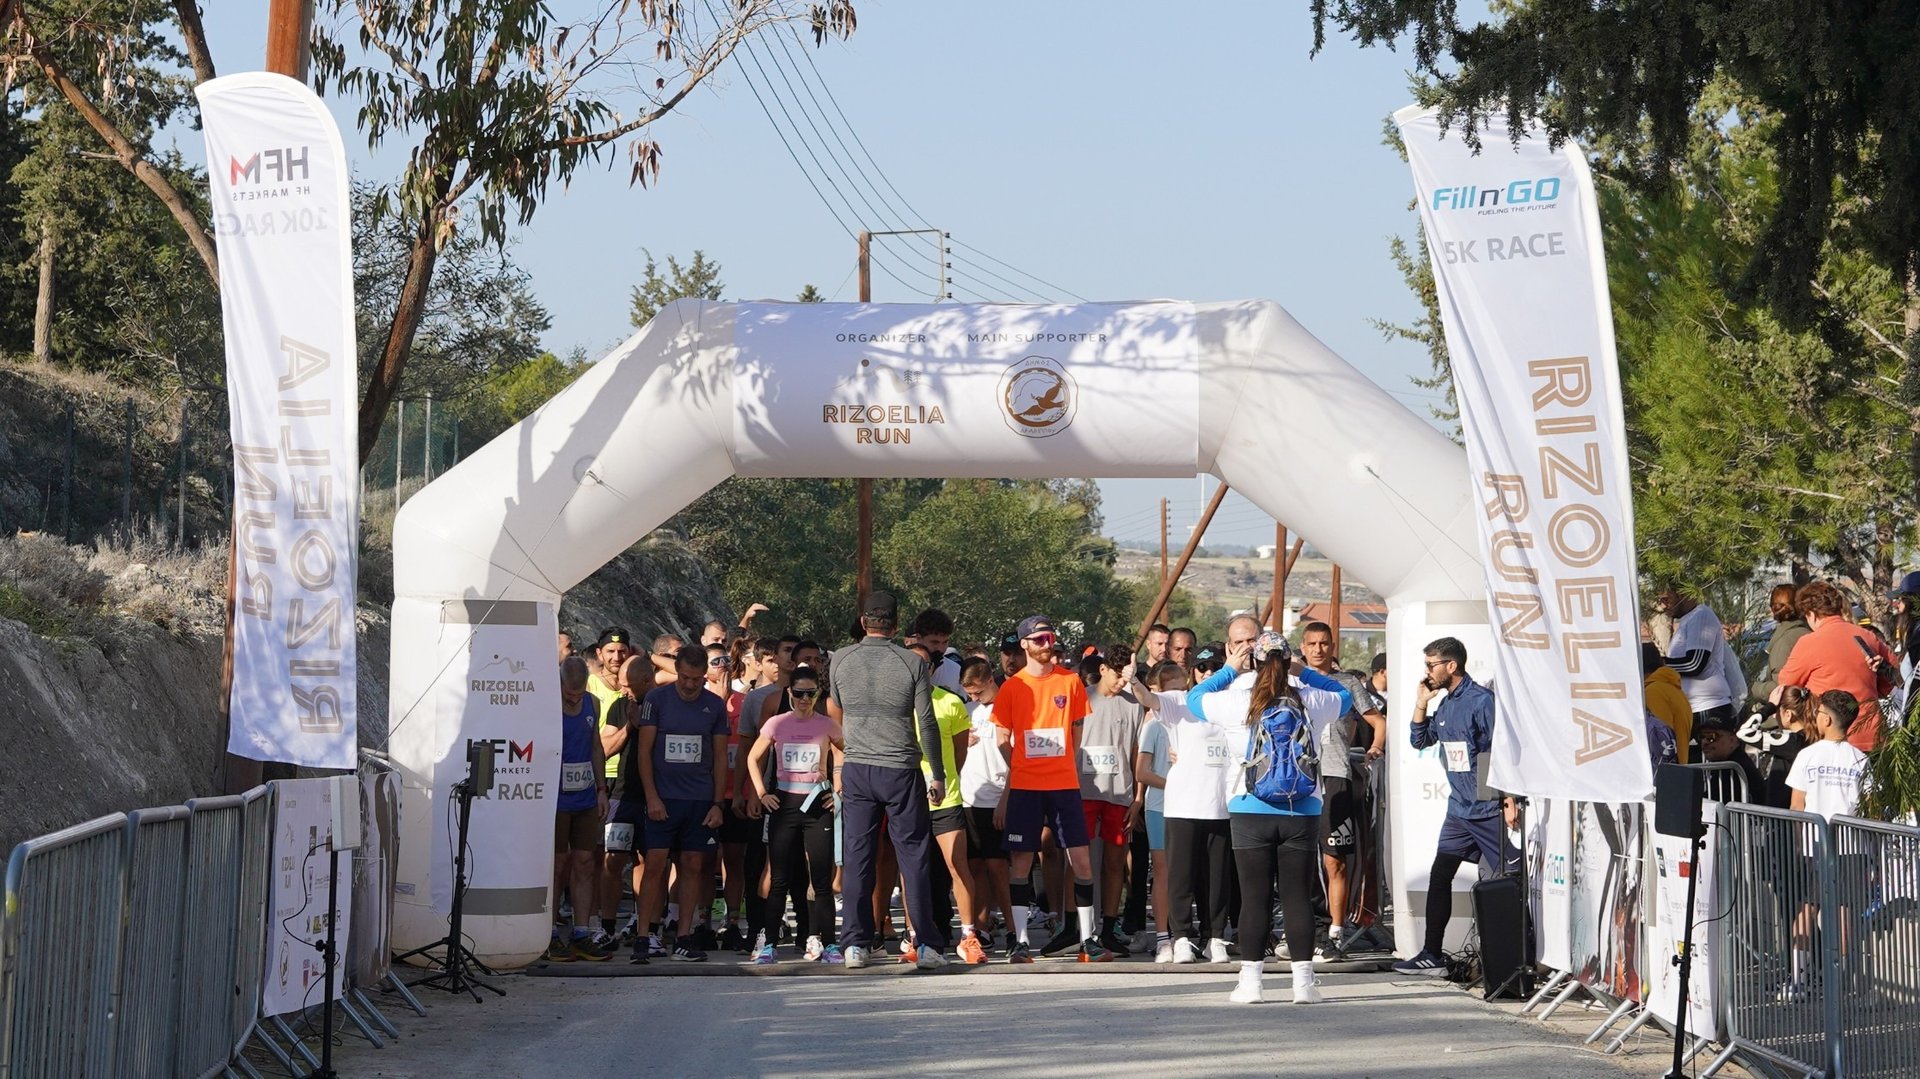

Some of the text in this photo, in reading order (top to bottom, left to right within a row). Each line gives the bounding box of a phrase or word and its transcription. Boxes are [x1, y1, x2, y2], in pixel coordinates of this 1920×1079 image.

[1478, 207, 1508, 215] FUELING
[1444, 232, 1565, 264] 5K RACE
[835, 333, 926, 344] ORGANIZER
[967, 333, 1107, 343] MAIN SUPPORTER
[823, 404, 944, 424] RIZOELIA
[856, 427, 911, 444] RUN
[1484, 472, 1551, 650] RUN
[1528, 356, 1633, 766] RIZOELIA
[471, 679, 535, 692] RIZOELIA
[489, 694, 519, 705] RUN
[669, 742, 699, 754] 5153
[785, 751, 817, 763] 5167
[1086, 754, 1116, 766] 5028
[566, 770, 592, 782] 5040
[498, 783, 544, 800] RACE
[1422, 783, 1448, 800] 5K
